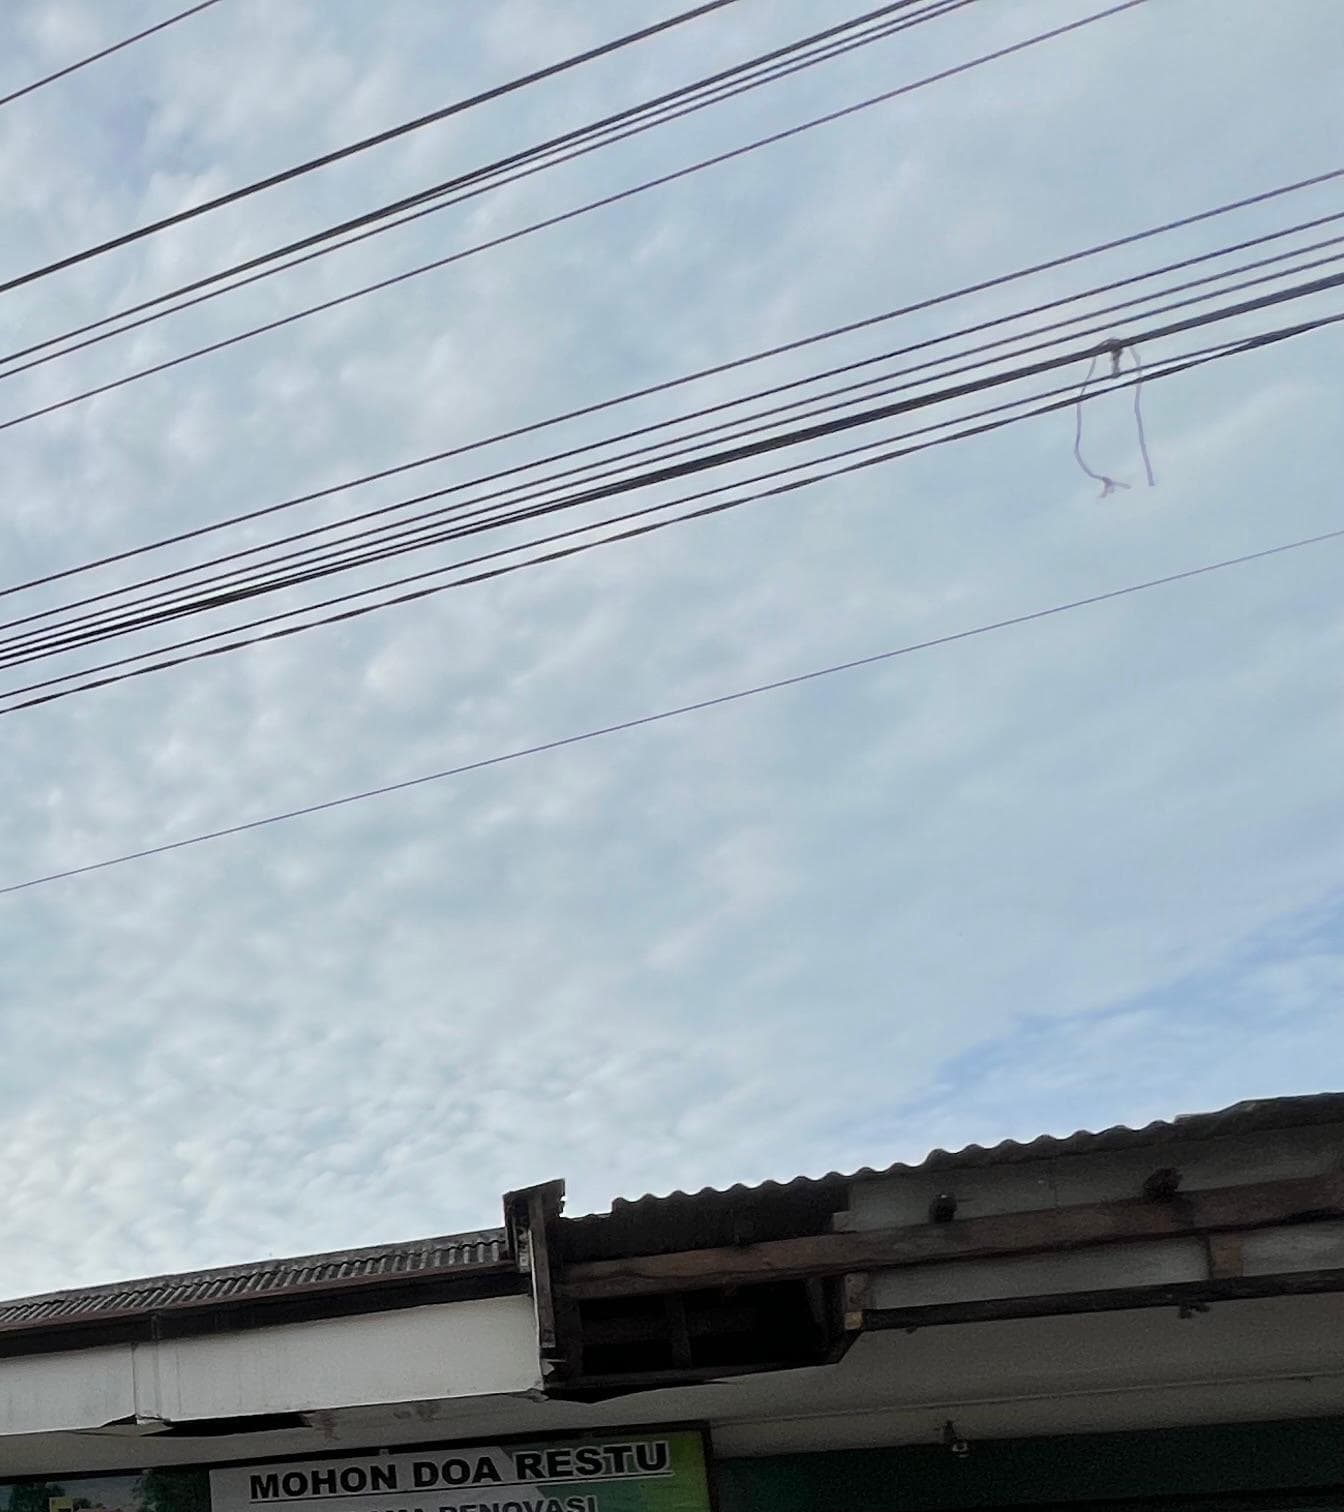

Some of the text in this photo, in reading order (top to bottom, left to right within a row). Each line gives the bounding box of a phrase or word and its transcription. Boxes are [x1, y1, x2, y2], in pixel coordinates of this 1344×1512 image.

[250, 1443, 668, 1500] MOHON DOA RESTU
